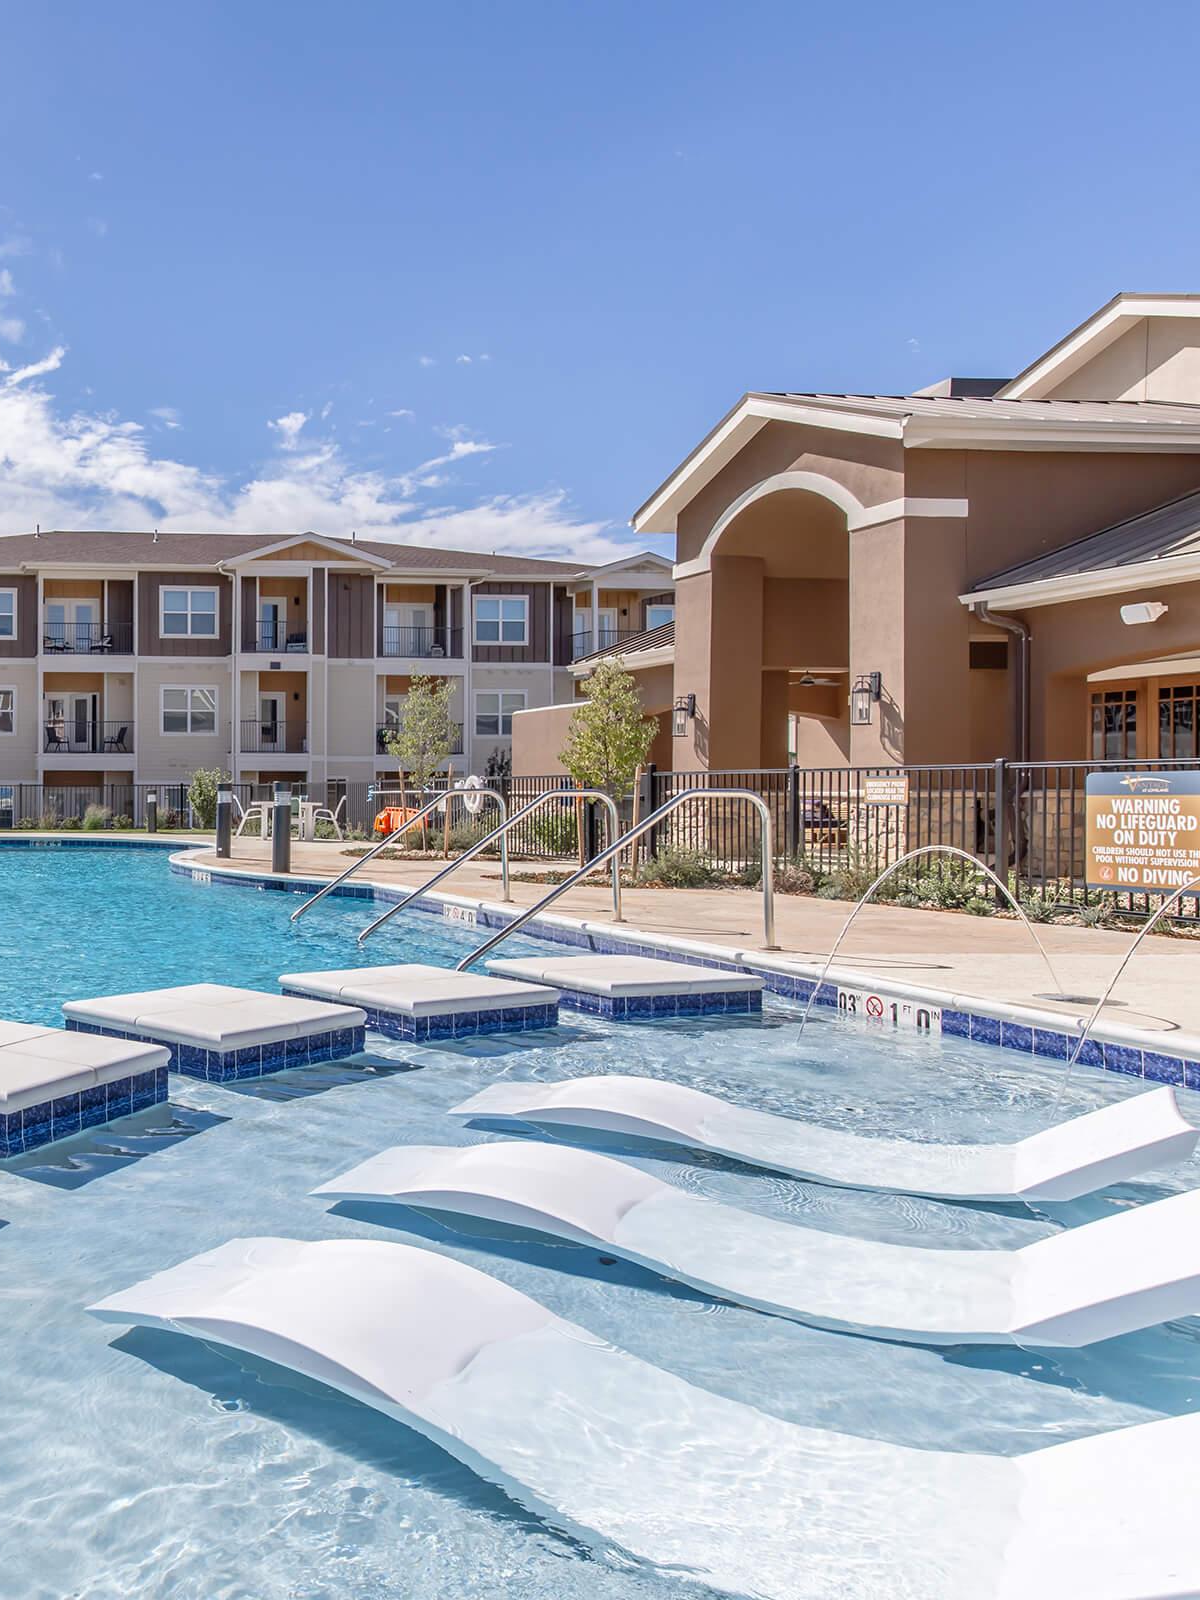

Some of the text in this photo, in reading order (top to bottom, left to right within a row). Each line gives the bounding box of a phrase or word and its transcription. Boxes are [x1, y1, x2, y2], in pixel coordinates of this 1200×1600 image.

[1111, 799, 1180, 815] WARNING
[1096, 814, 1198, 831] NO LIFEGUARD
[1114, 830, 1178, 847] ON DUTY
[1092, 846, 1125, 855] CHILDREN
[1126, 848, 1154, 857] SHOULD
[1156, 849, 1171, 857] NOT
[1173, 850, 1187, 858] USE
[1096, 855, 1199, 867] POOL WITHOUT SUPERVISION
[1118, 867, 1194, 886] NO DIVING
[889, 1003, 898, 1021] 1
[902, 1005, 912, 1013] FT
[931, 1011, 941, 1020] IN
